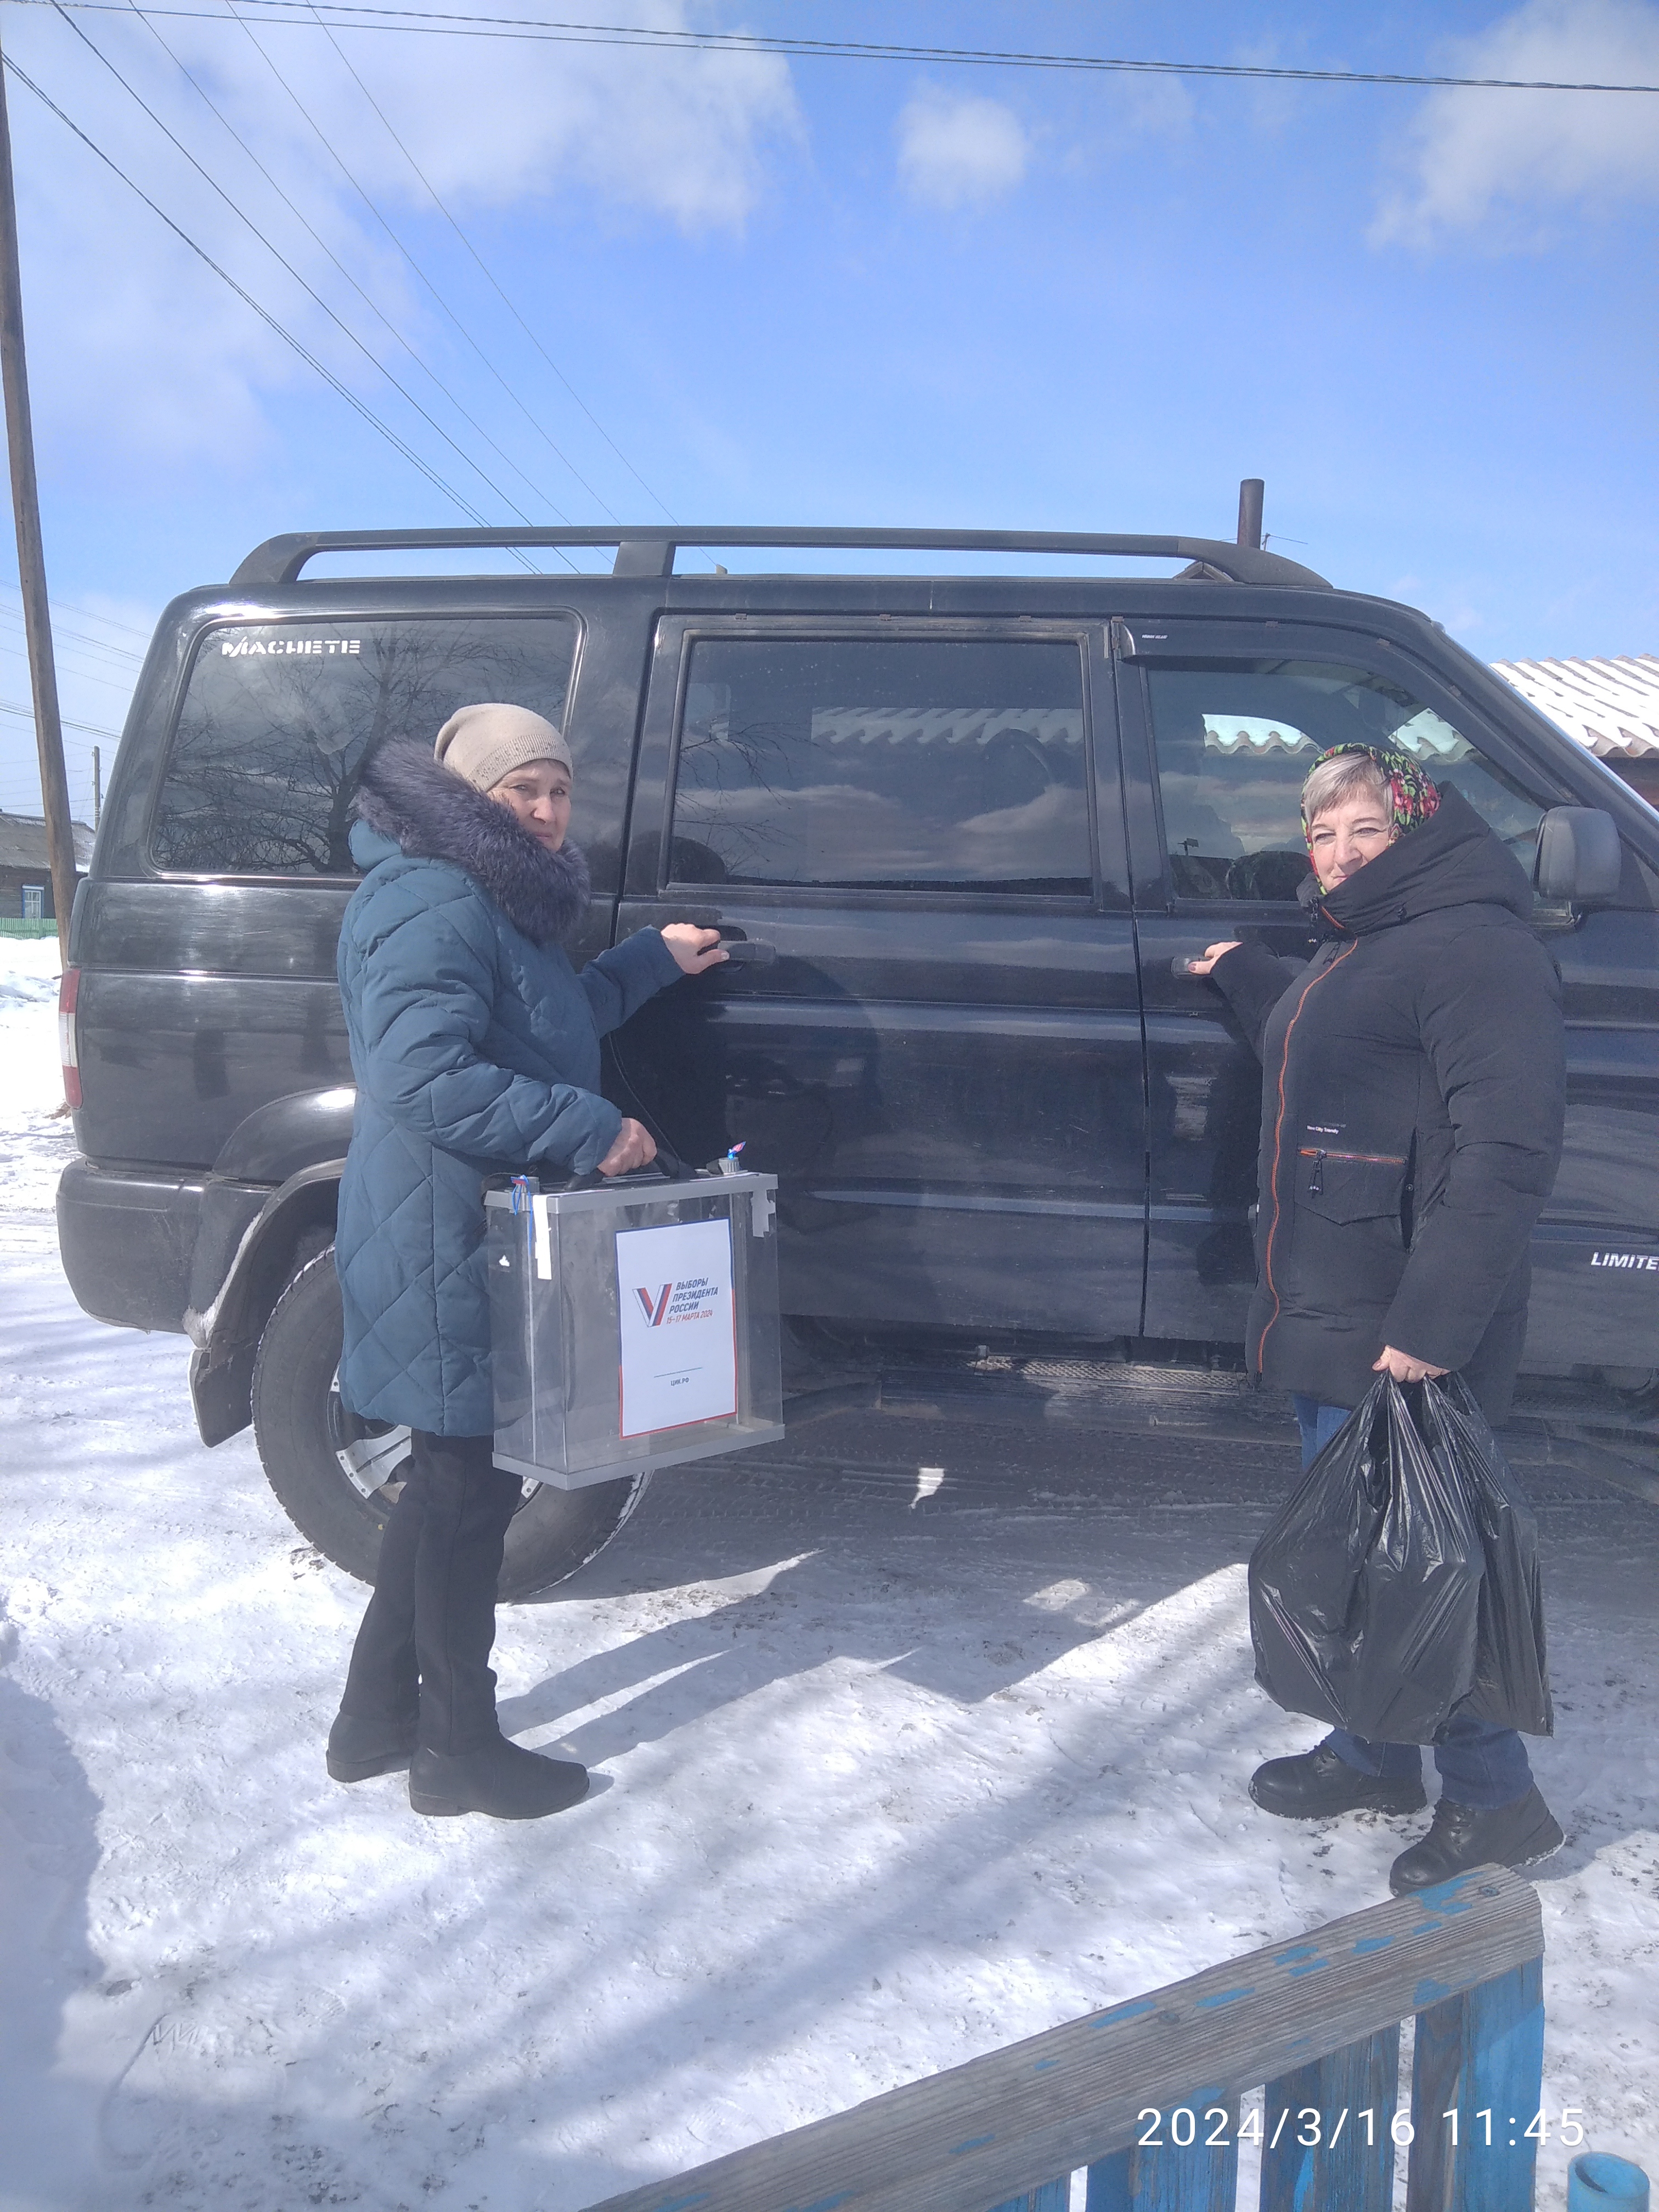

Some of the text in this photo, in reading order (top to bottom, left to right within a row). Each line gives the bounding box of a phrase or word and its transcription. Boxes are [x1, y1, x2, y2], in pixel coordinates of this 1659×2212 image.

[222, 636, 360, 657] MACHETE
[1591, 1251, 1659, 1271] LIMITE
[675, 1277, 709, 1291] ВЫБОРЫ
[672, 1286, 719, 1302] ПРЕЗИДЕНТА
[669, 1301, 699, 1314] РОССИИ
[681, 1312, 699, 1322] МАРТА
[700, 1310, 713, 1319] 2024
[670, 1377, 690, 1386] ЦИК.РФ
